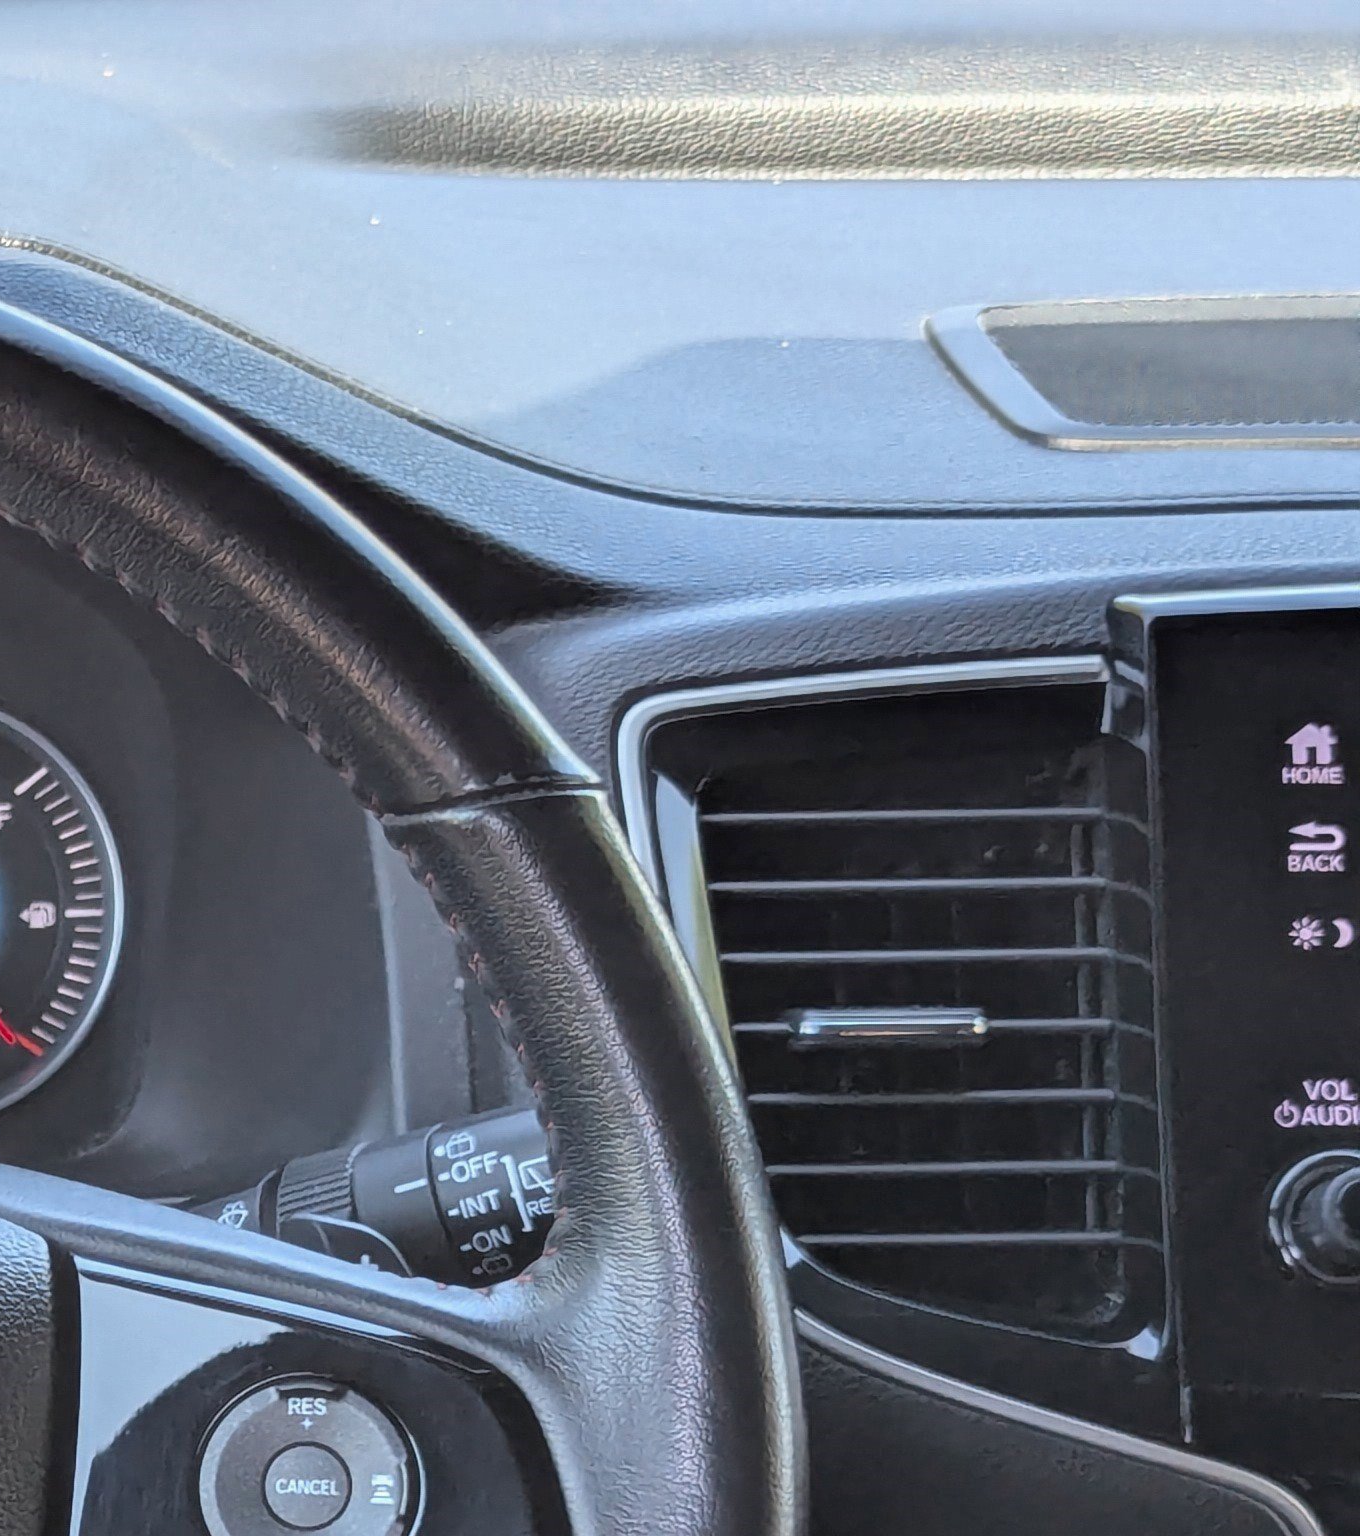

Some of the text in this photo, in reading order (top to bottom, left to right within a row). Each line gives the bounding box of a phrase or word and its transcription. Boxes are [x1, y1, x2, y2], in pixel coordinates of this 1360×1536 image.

[1282, 767, 1342, 784] HOME
[1288, 854, 1344, 873] BACK
[1302, 1079, 1358, 1101] VOL
[1301, 1104, 1360, 1126] AUDI
[451, 1151, 498, 1183] OFF
[472, 1225, 513, 1253] ON
[287, 1397, 327, 1416] RES
[275, 1479, 341, 1496] CANCEL
